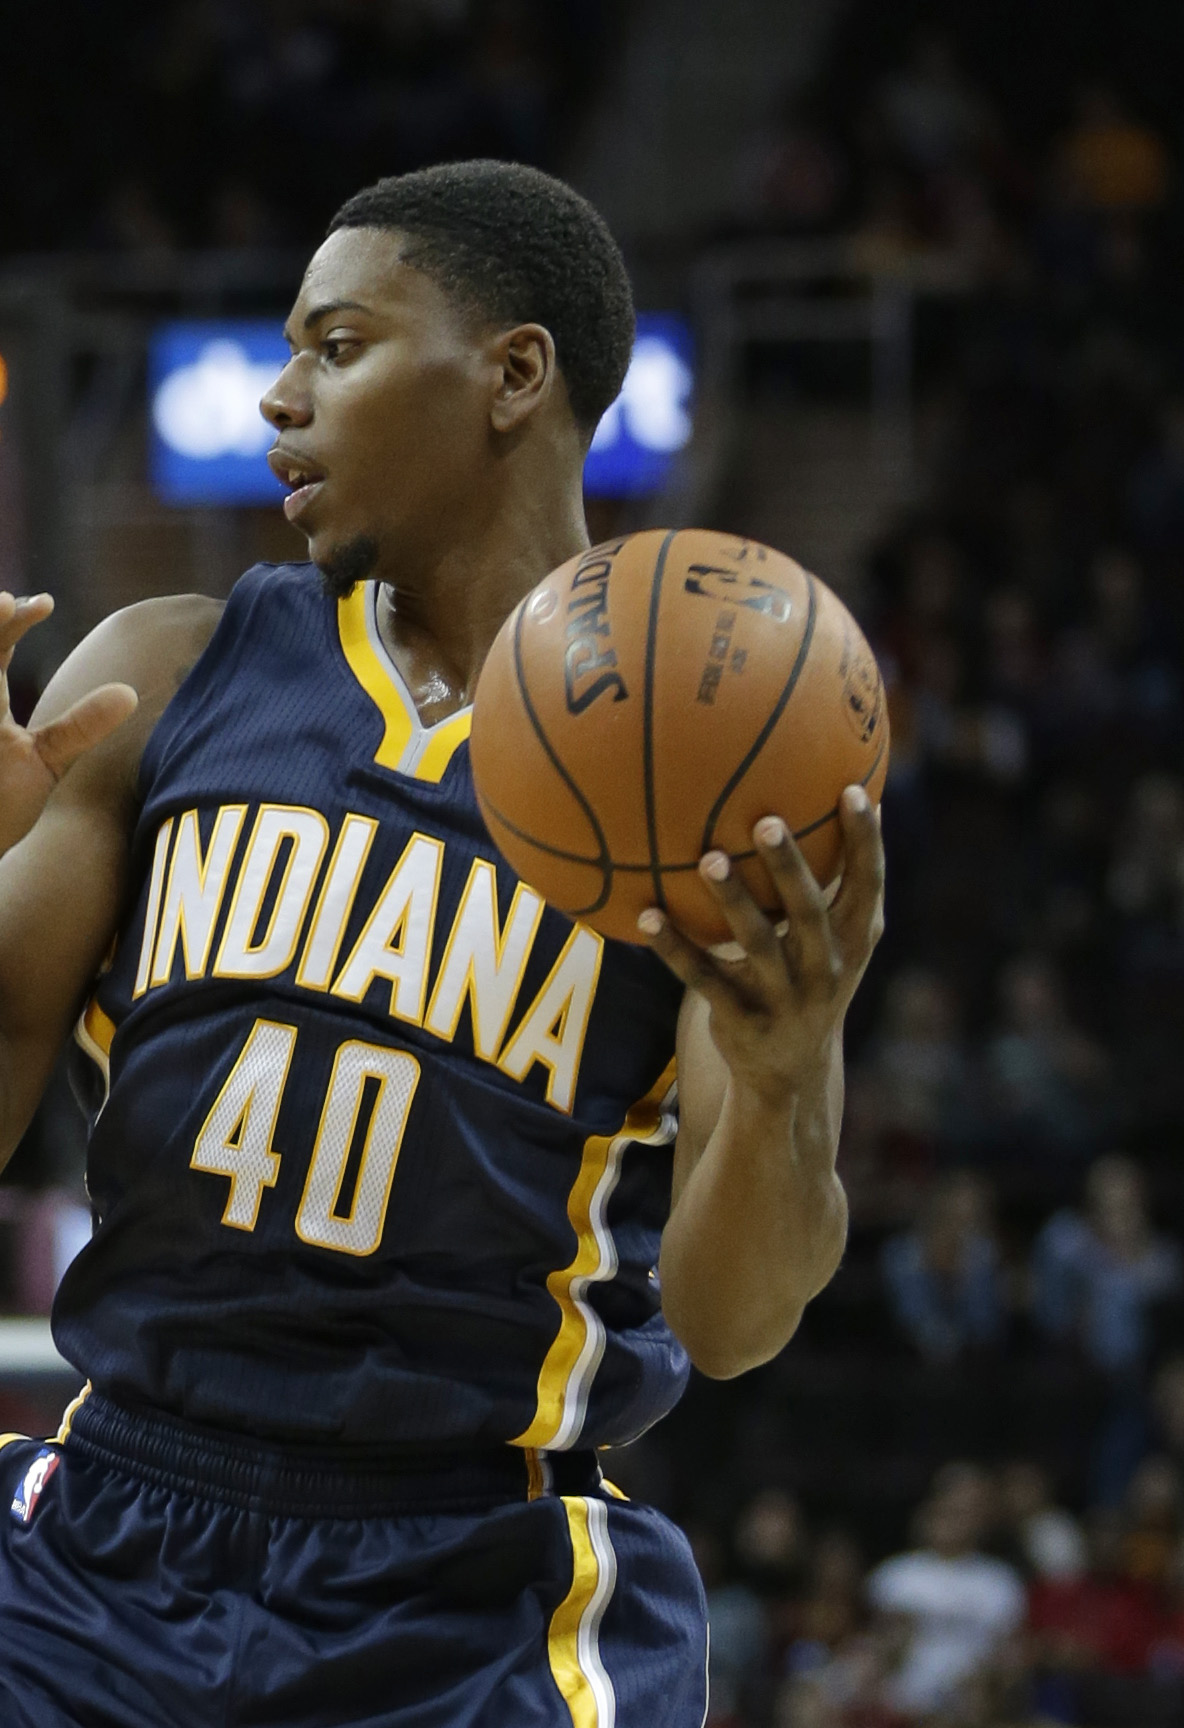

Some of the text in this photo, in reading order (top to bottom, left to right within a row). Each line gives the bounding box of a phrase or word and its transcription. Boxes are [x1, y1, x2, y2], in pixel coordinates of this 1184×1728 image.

[564, 538, 628, 717] SPALD
[132, 802, 605, 1116] INDIANA
[189, 1017, 422, 1258] 40
